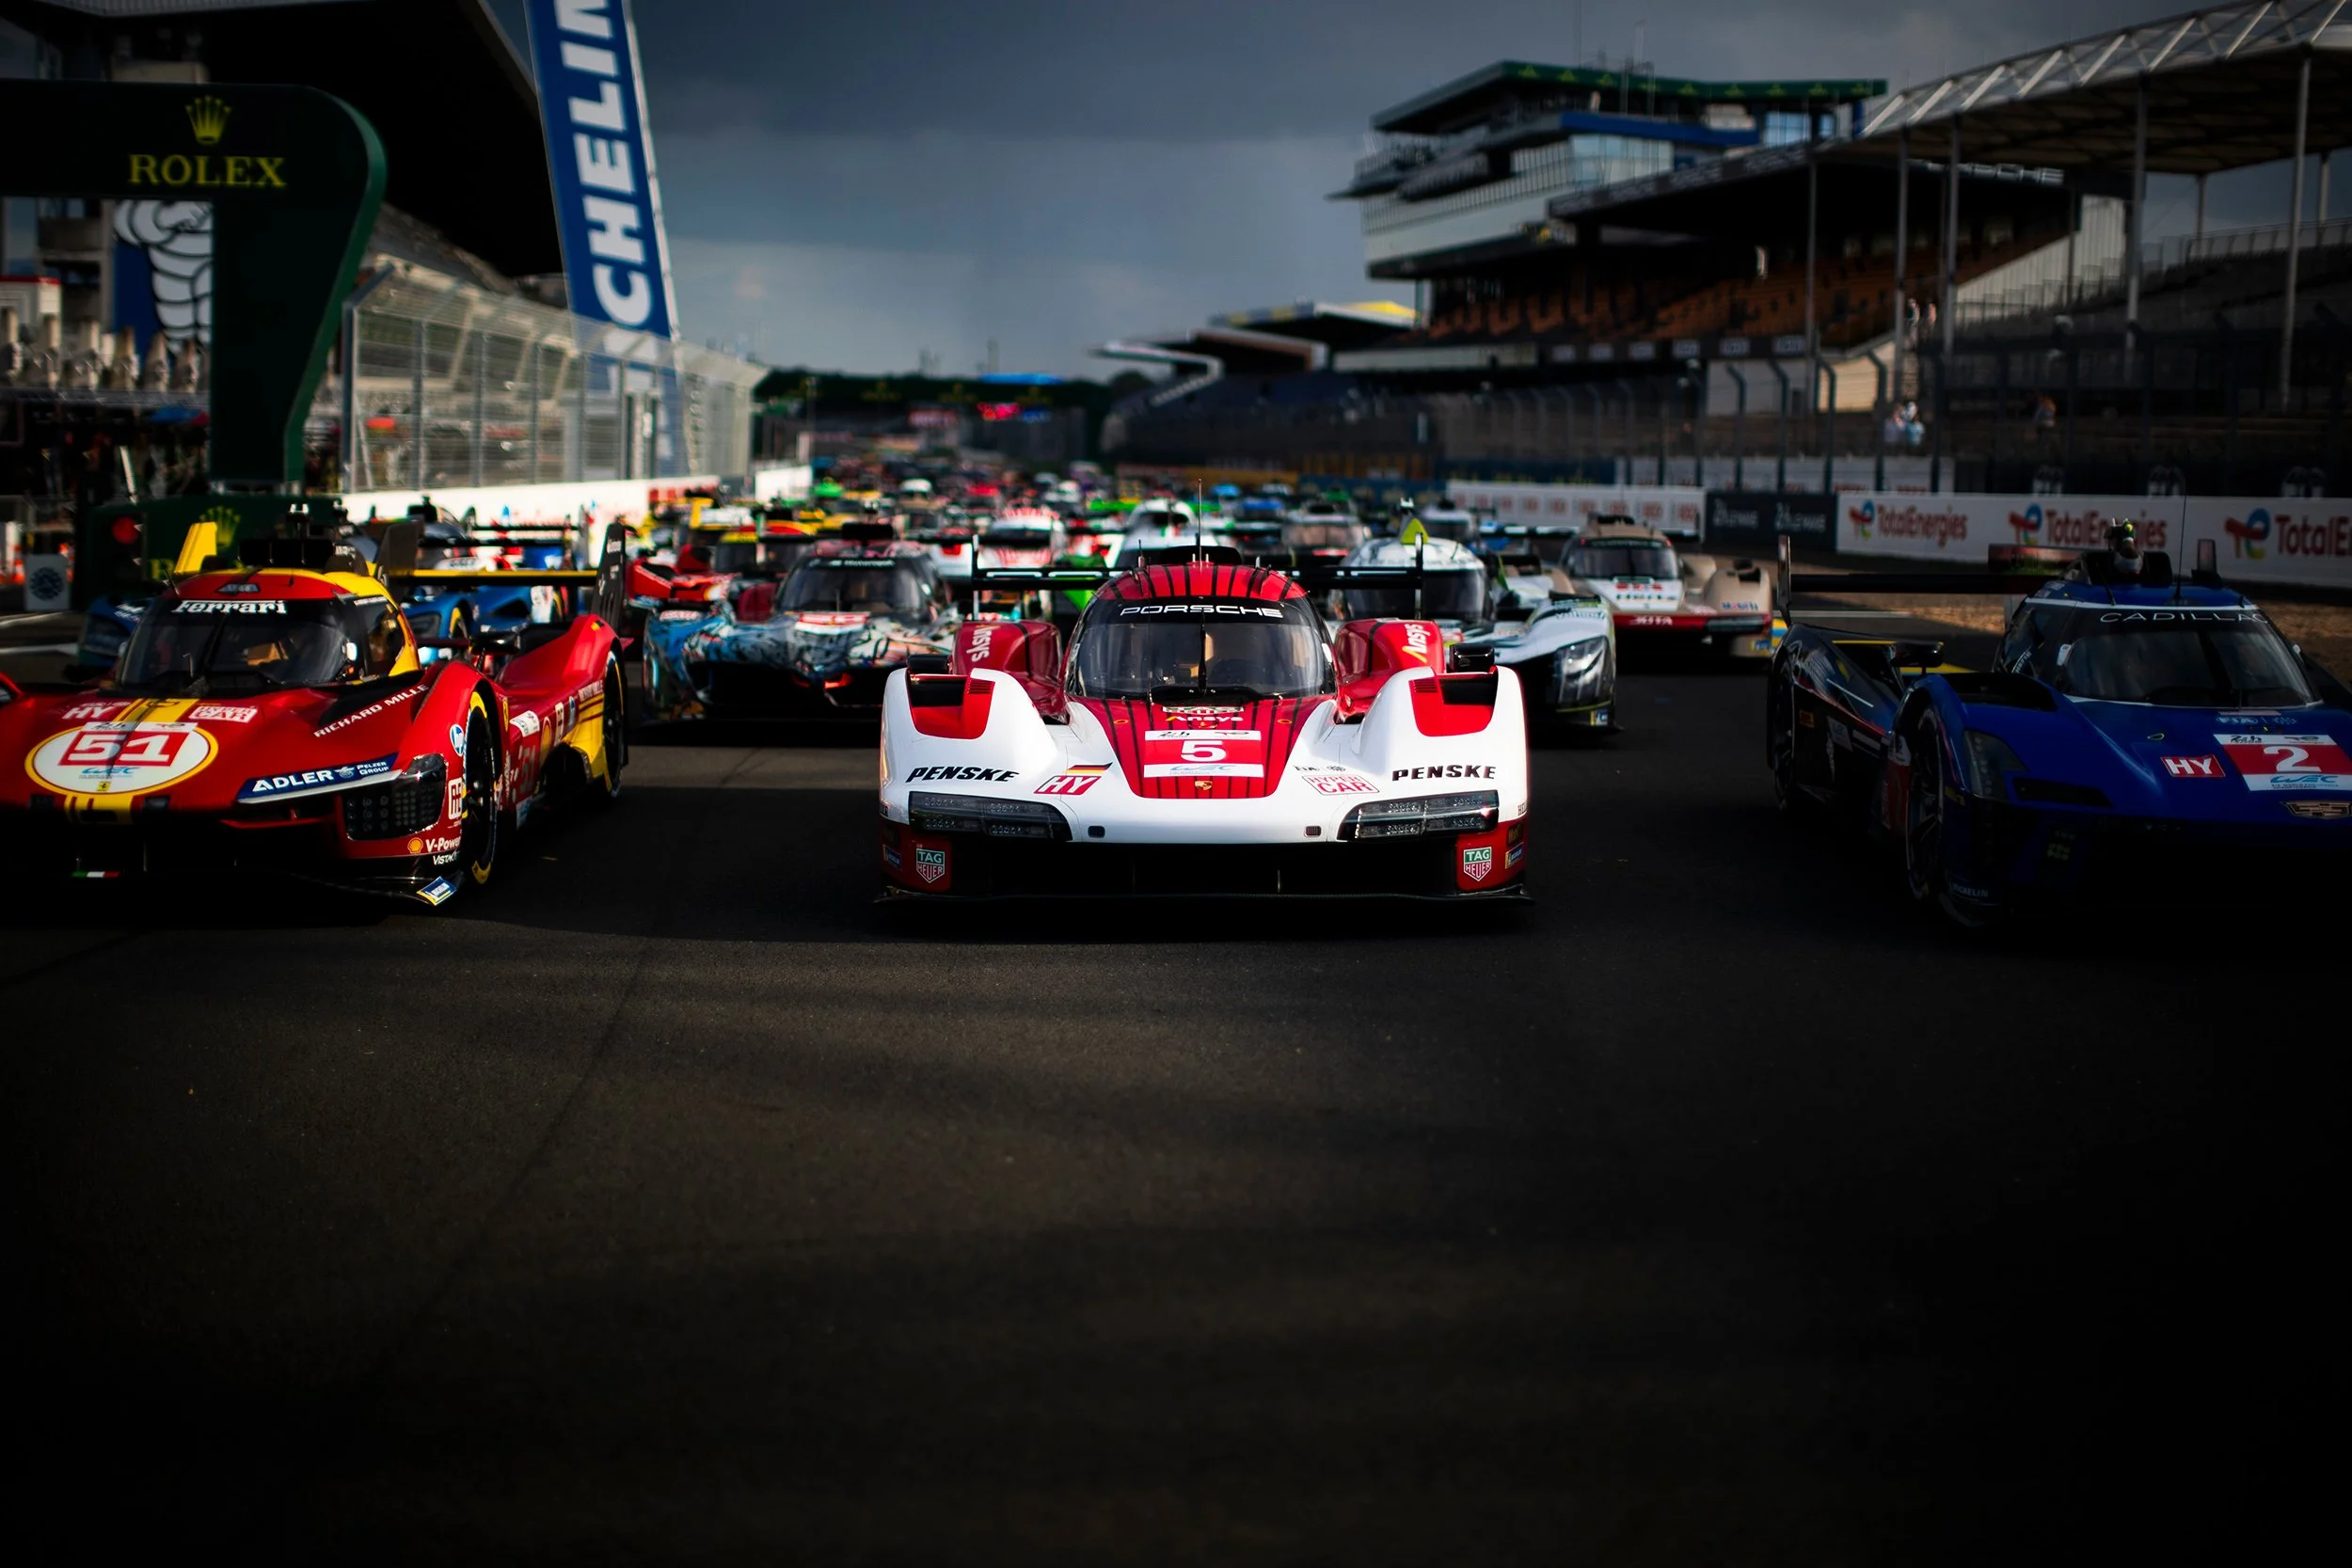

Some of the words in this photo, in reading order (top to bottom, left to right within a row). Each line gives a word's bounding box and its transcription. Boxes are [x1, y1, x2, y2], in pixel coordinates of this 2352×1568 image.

[128, 154, 286, 187] ROLEX
[1878, 505, 1968, 547] TotalEnergies
[2275, 515, 2352, 556] TotalE
[171, 599, 288, 614] Ferrari
[1120, 605, 1283, 618] PORSCHE
[2100, 612, 2269, 624] CADILLAC
[966, 624, 1001, 662] Ansys
[1402, 624, 1431, 664] Ansys
[62, 705, 116, 720] HY
[313, 704, 383, 738] RICHARD
[383, 683, 429, 706] MILLE
[67, 734, 170, 762] 51
[1180, 740, 1227, 762] 5
[357, 761, 387, 770] PELZER
[2165, 758, 2213, 775] HY
[2264, 746, 2322, 772] 2
[358, 766, 389, 775] GROUP
[906, 767, 1019, 783] PENSKE
[1391, 765, 1496, 782] PENSKE
[2270, 774, 2339, 783] WEC
[251, 770, 334, 792] ADLER
[1038, 776, 1083, 794] HY
[1317, 783, 1372, 793] CAR
[918, 850, 943, 863] TAG
[1466, 849, 1490, 862] TAG
[917, 863, 944, 879] HEUER
[1465, 863, 1491, 879] HEUER
